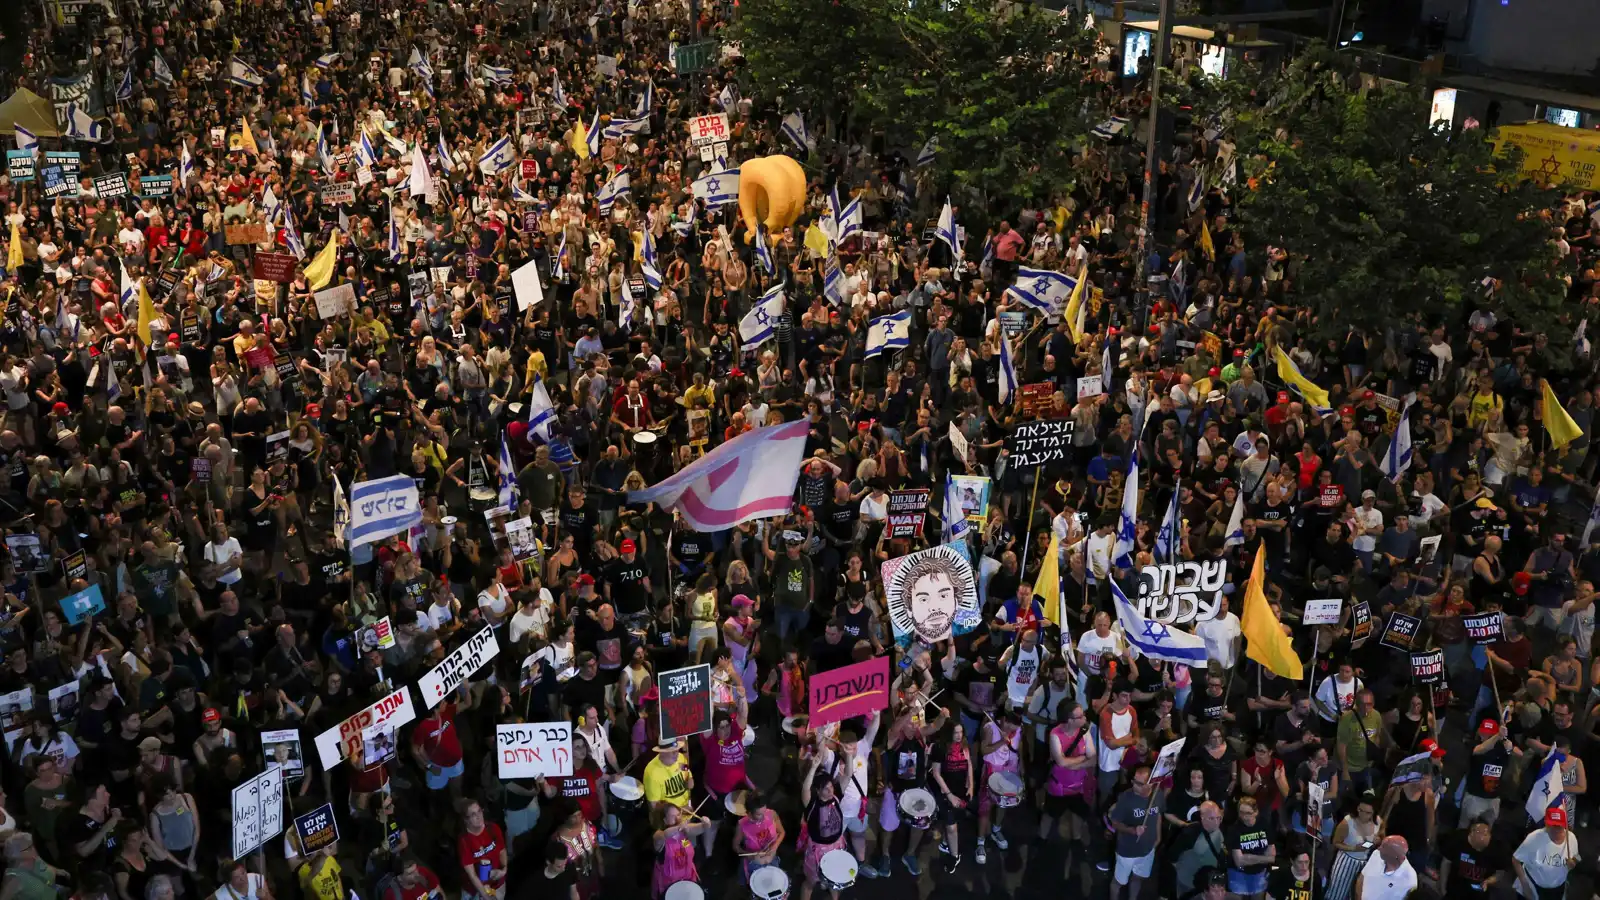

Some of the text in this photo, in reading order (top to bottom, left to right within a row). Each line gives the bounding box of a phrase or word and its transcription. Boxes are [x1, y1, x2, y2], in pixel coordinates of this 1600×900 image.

[697, 116, 721, 129] מים
[699, 125, 725, 137] קרים
[1569, 160, 1596, 171] מגן דוד
[1574, 171, 1594, 179] אדום
[1015, 434, 1072, 452] המדינה
[891, 493, 929, 504] לא שכחנו
[890, 503, 917, 511] ההפקרה
[889, 515, 923, 525] WAR
[620, 569, 643, 583] 7.10
[1138, 558, 1228, 597] שביתה
[1137, 589, 1223, 626] עכשיו
[963, 618, 978, 628] אלון
[1395, 618, 1414, 629] אין לנו
[1464, 615, 1500, 628] לא שכחנו
[1393, 625, 1410, 633] ילדים
[1468, 625, 1500, 637] את 7.10
[435, 650, 463, 679] ברור
[1412, 652, 1442, 666] לא שכחנו
[1415, 664, 1441, 676] את 7.10
[816, 672, 884, 706] תשבתו
[374, 691, 404, 715] מחר
[497, 728, 568, 745] כבר נחצה
[503, 746, 569, 774] קו אדום
[249, 779, 270, 796] בי בי
[563, 778, 588, 787] מדינה
[664, 773, 687, 796] NOW
[562, 787, 590, 797] חטופה
[304, 812, 326, 829] אין לנו
[307, 821, 327, 835] ילדים
